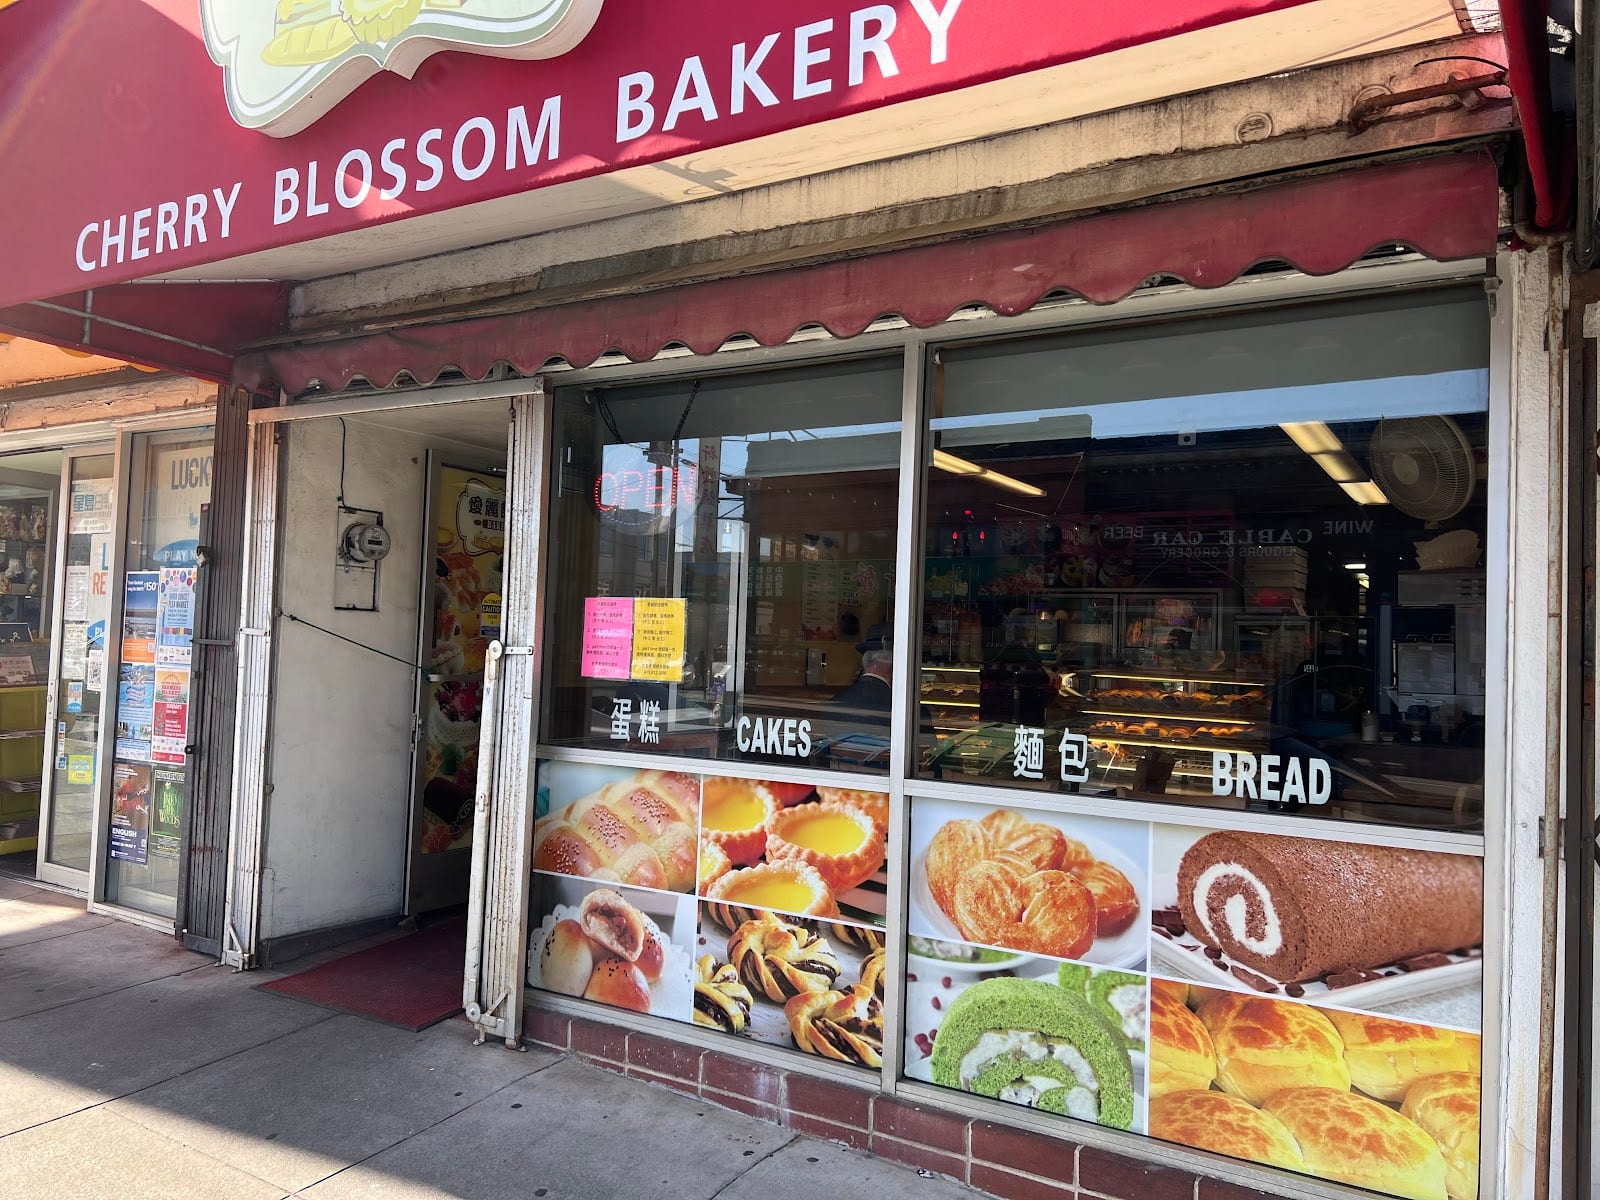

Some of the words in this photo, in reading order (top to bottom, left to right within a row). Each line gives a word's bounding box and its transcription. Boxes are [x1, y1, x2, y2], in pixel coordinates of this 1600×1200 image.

[75, 182, 242, 272] CHERRY
[273, 95, 561, 226] BLOSSOM
[616, 0, 963, 143] BAKERY
[594, 464, 697, 511] OPEN
[164, 550, 187, 562] PLAY
[482, 605, 501, 614] CAUTIO
[610, 698, 661, 744] 蛋糕
[737, 716, 812, 758] CAKES
[1013, 724, 1090, 783] 麵包
[1212, 751, 1332, 805] BREAD
[112, 827, 137, 838] ENGLISH
